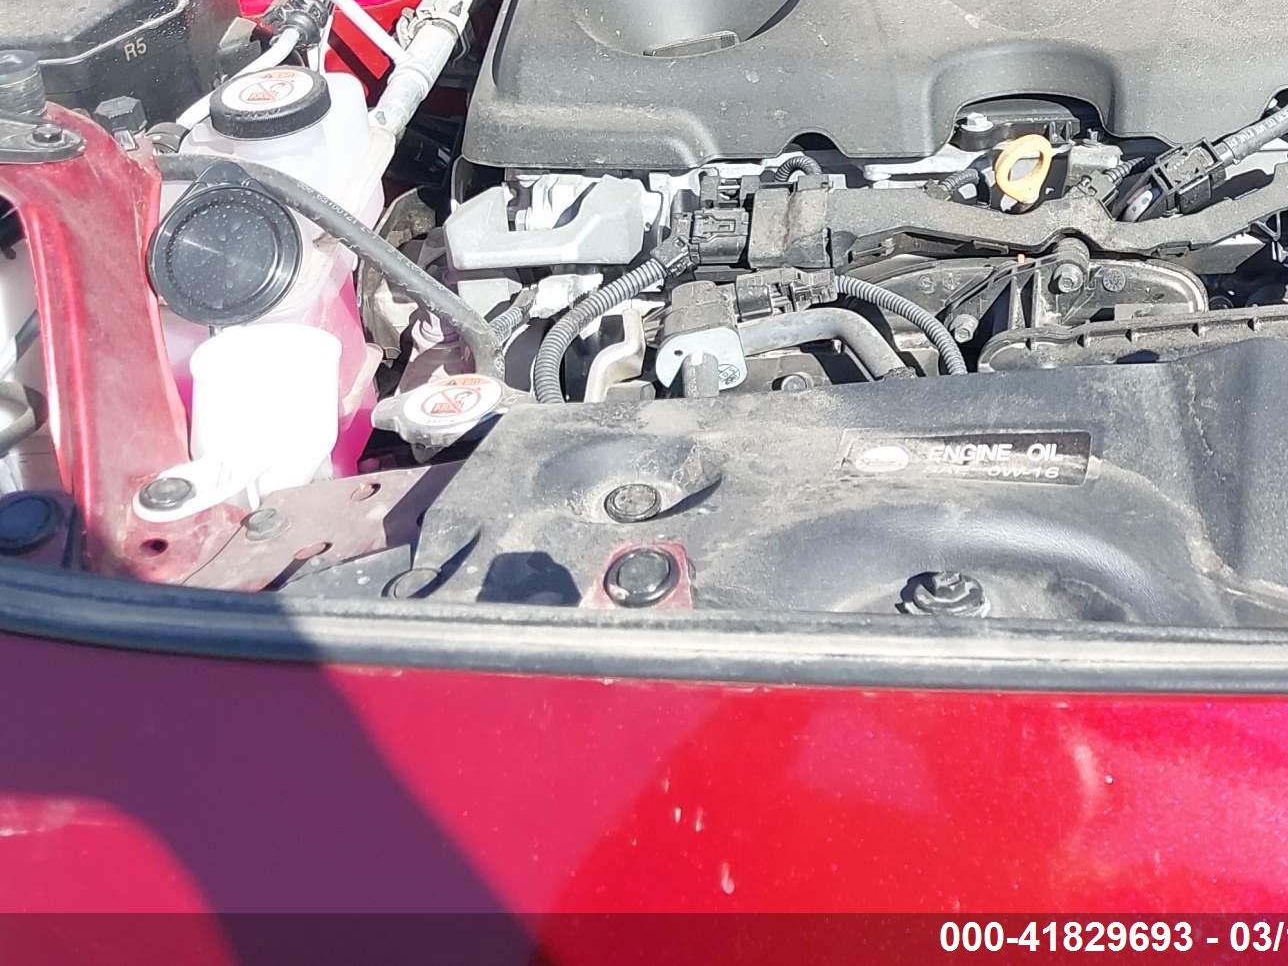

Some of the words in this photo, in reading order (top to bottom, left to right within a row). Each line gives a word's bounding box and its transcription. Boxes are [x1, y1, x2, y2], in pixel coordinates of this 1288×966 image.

[124, 36, 147, 62] R5
[928, 443, 1013, 462] ENGINE
[1026, 442, 1065, 462] OIL
[986, 465, 1060, 479] 0W-16
